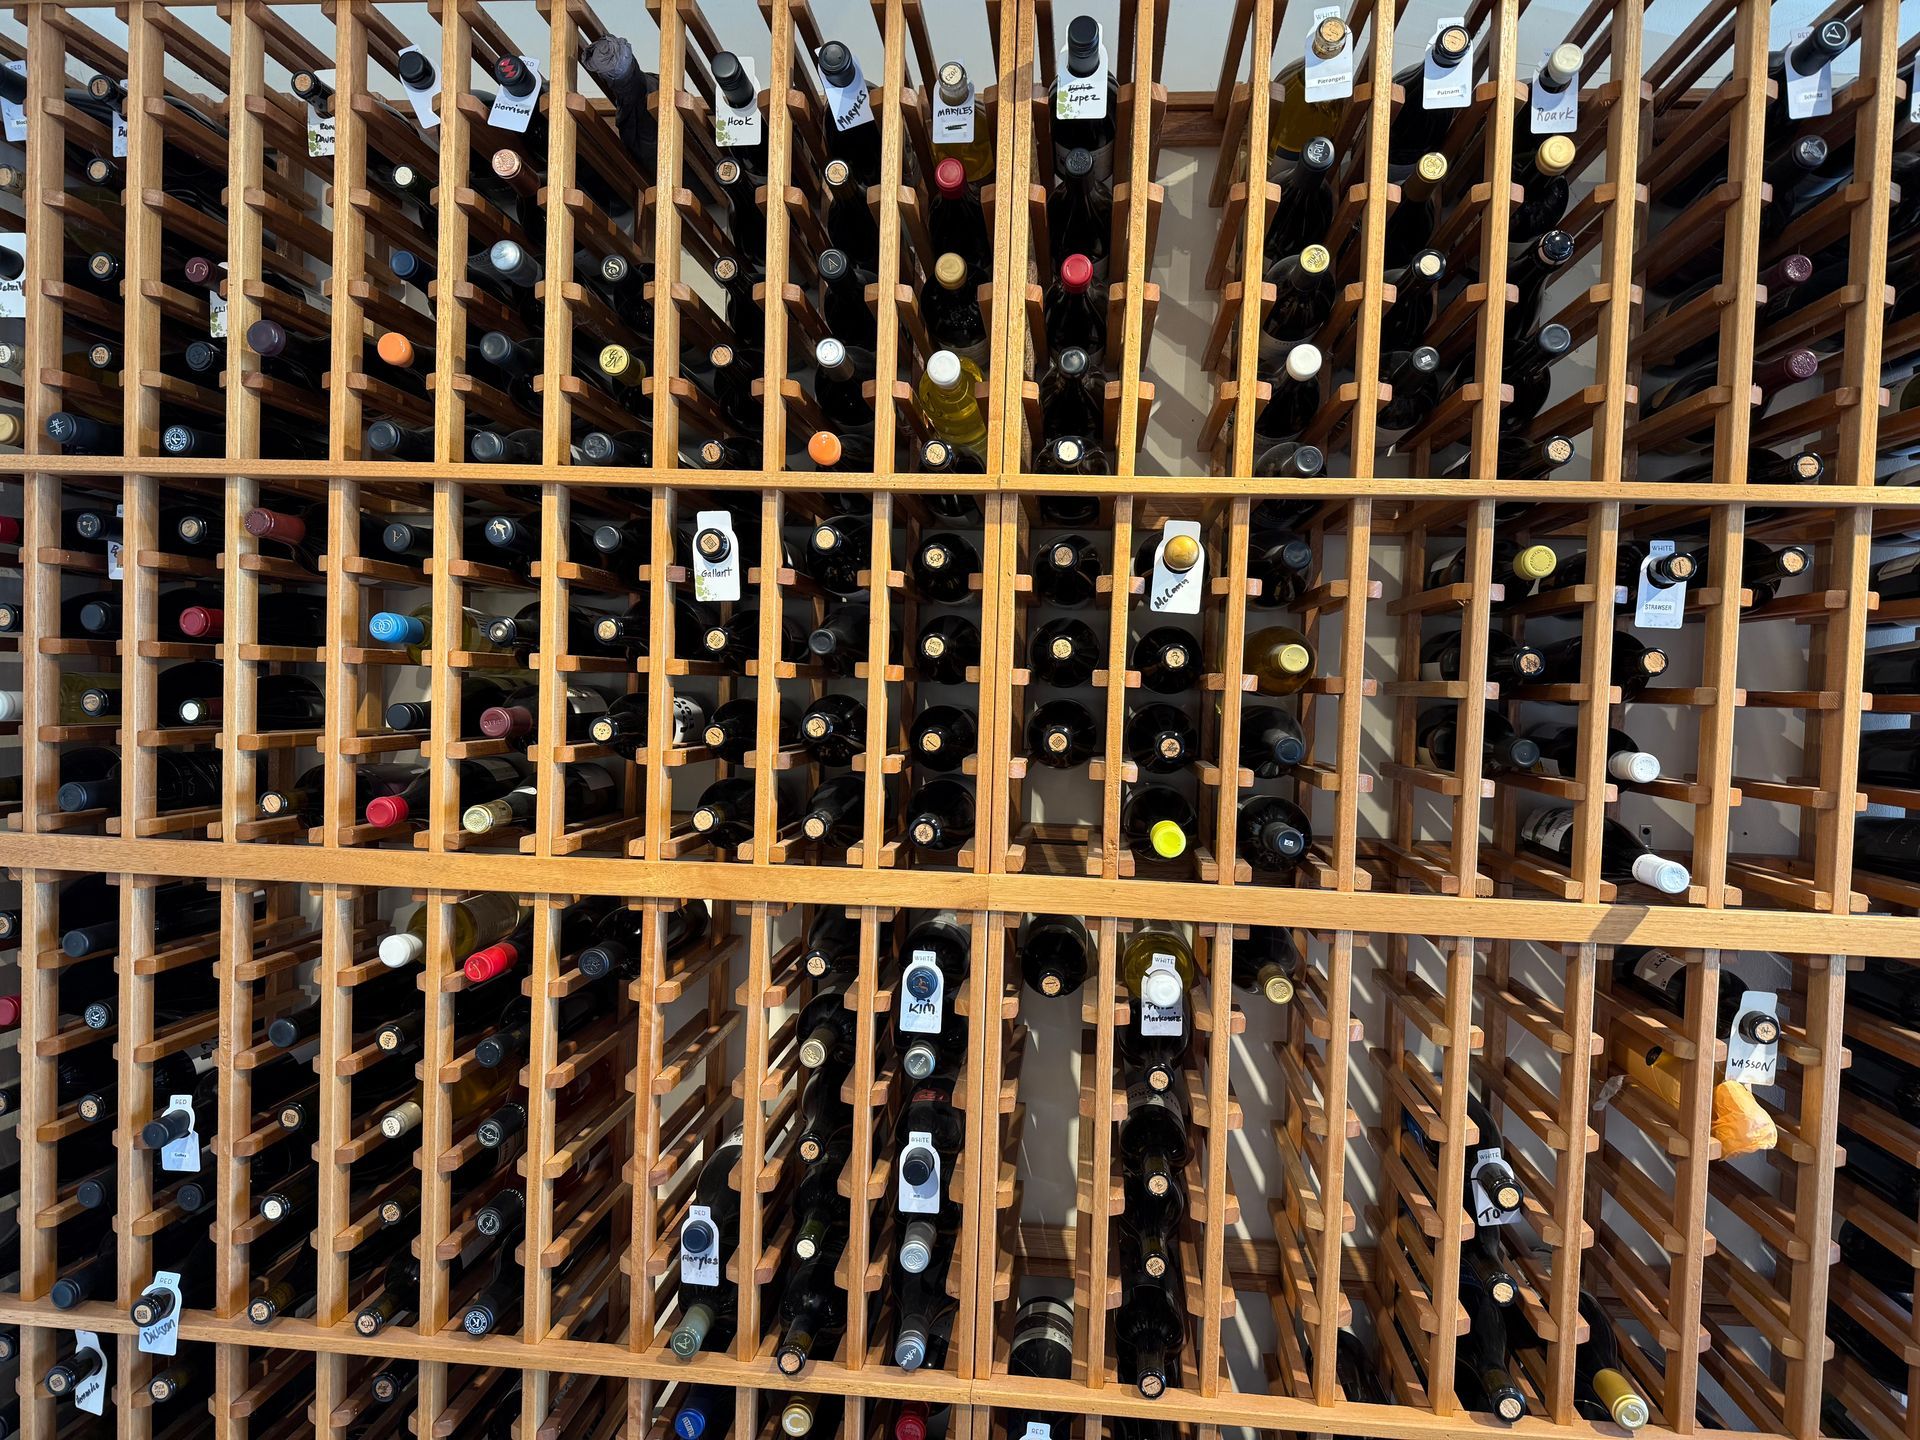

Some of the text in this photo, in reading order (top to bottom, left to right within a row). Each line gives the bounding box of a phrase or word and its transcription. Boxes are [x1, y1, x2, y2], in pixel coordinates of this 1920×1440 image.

[937, 107, 973, 117] MARYLES
[1645, 603, 1672, 611] STRAWSER
[1155, 957, 1174, 965] WHITE
[1731, 1058, 1775, 1072] WASSON
[1479, 1152, 1499, 1160] WHITE
[143, 1319, 176, 1345] Dickson
